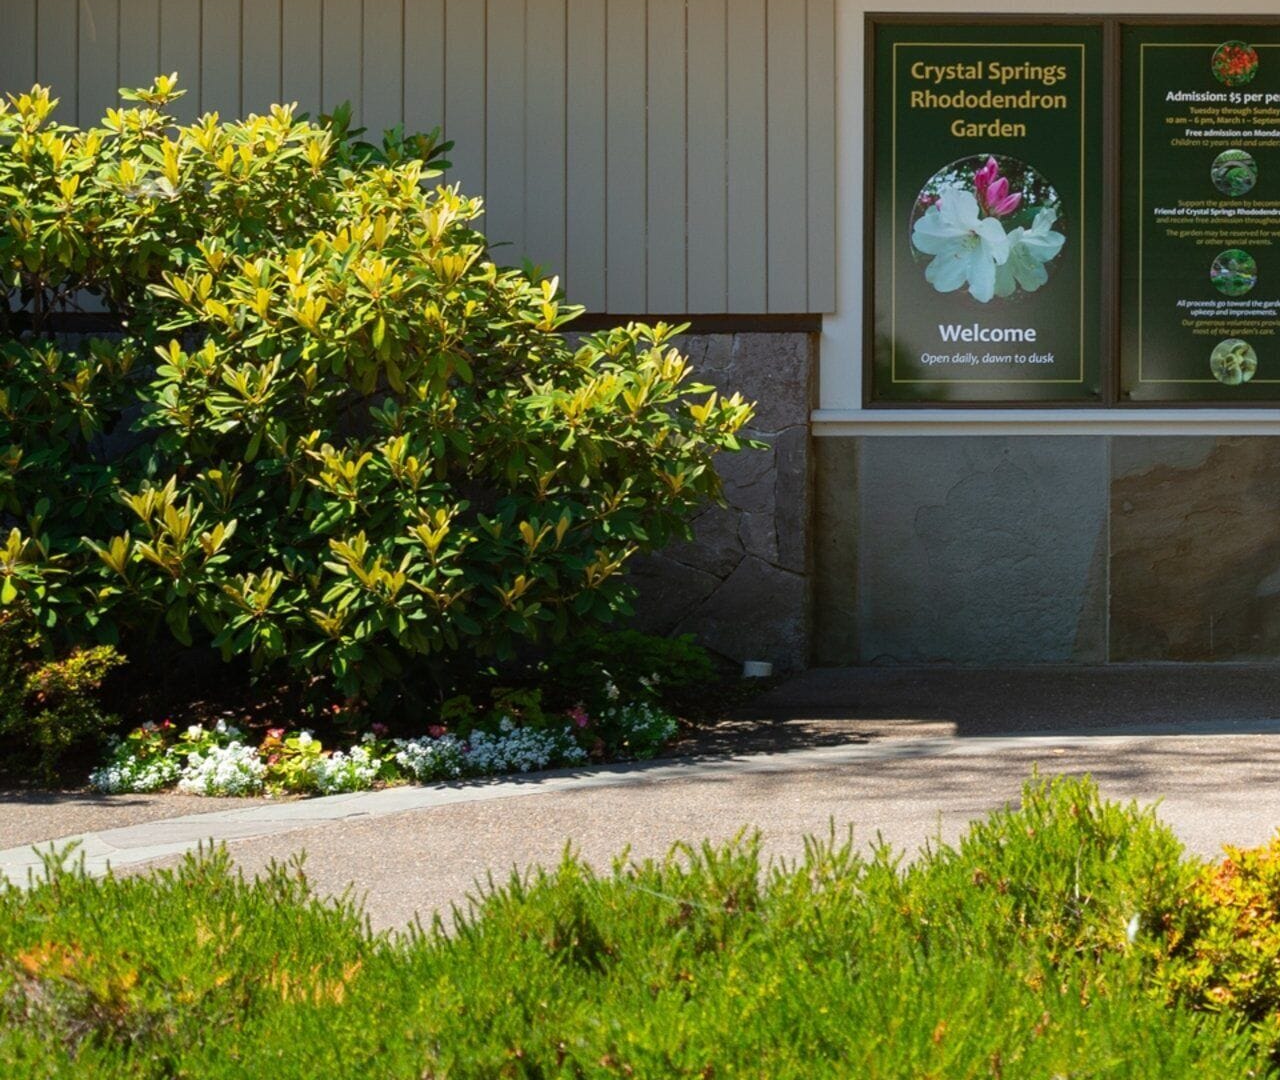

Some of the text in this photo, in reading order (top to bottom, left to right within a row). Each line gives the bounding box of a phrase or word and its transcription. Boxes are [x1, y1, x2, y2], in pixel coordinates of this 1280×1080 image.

[911, 61, 1066, 85] Crystal Springs
[911, 90, 1066, 109] Rhododendron
[1166, 91, 1227, 101] Admission:
[1230, 92, 1241, 103] $5
[1244, 94, 1263, 104] per
[1190, 107, 1280, 116] Tuesday through Sunday
[951, 120, 1026, 137] Garden
[939, 324, 1036, 342] Welcome
[921, 353, 1054, 365] Open daily, dawn to dusk
